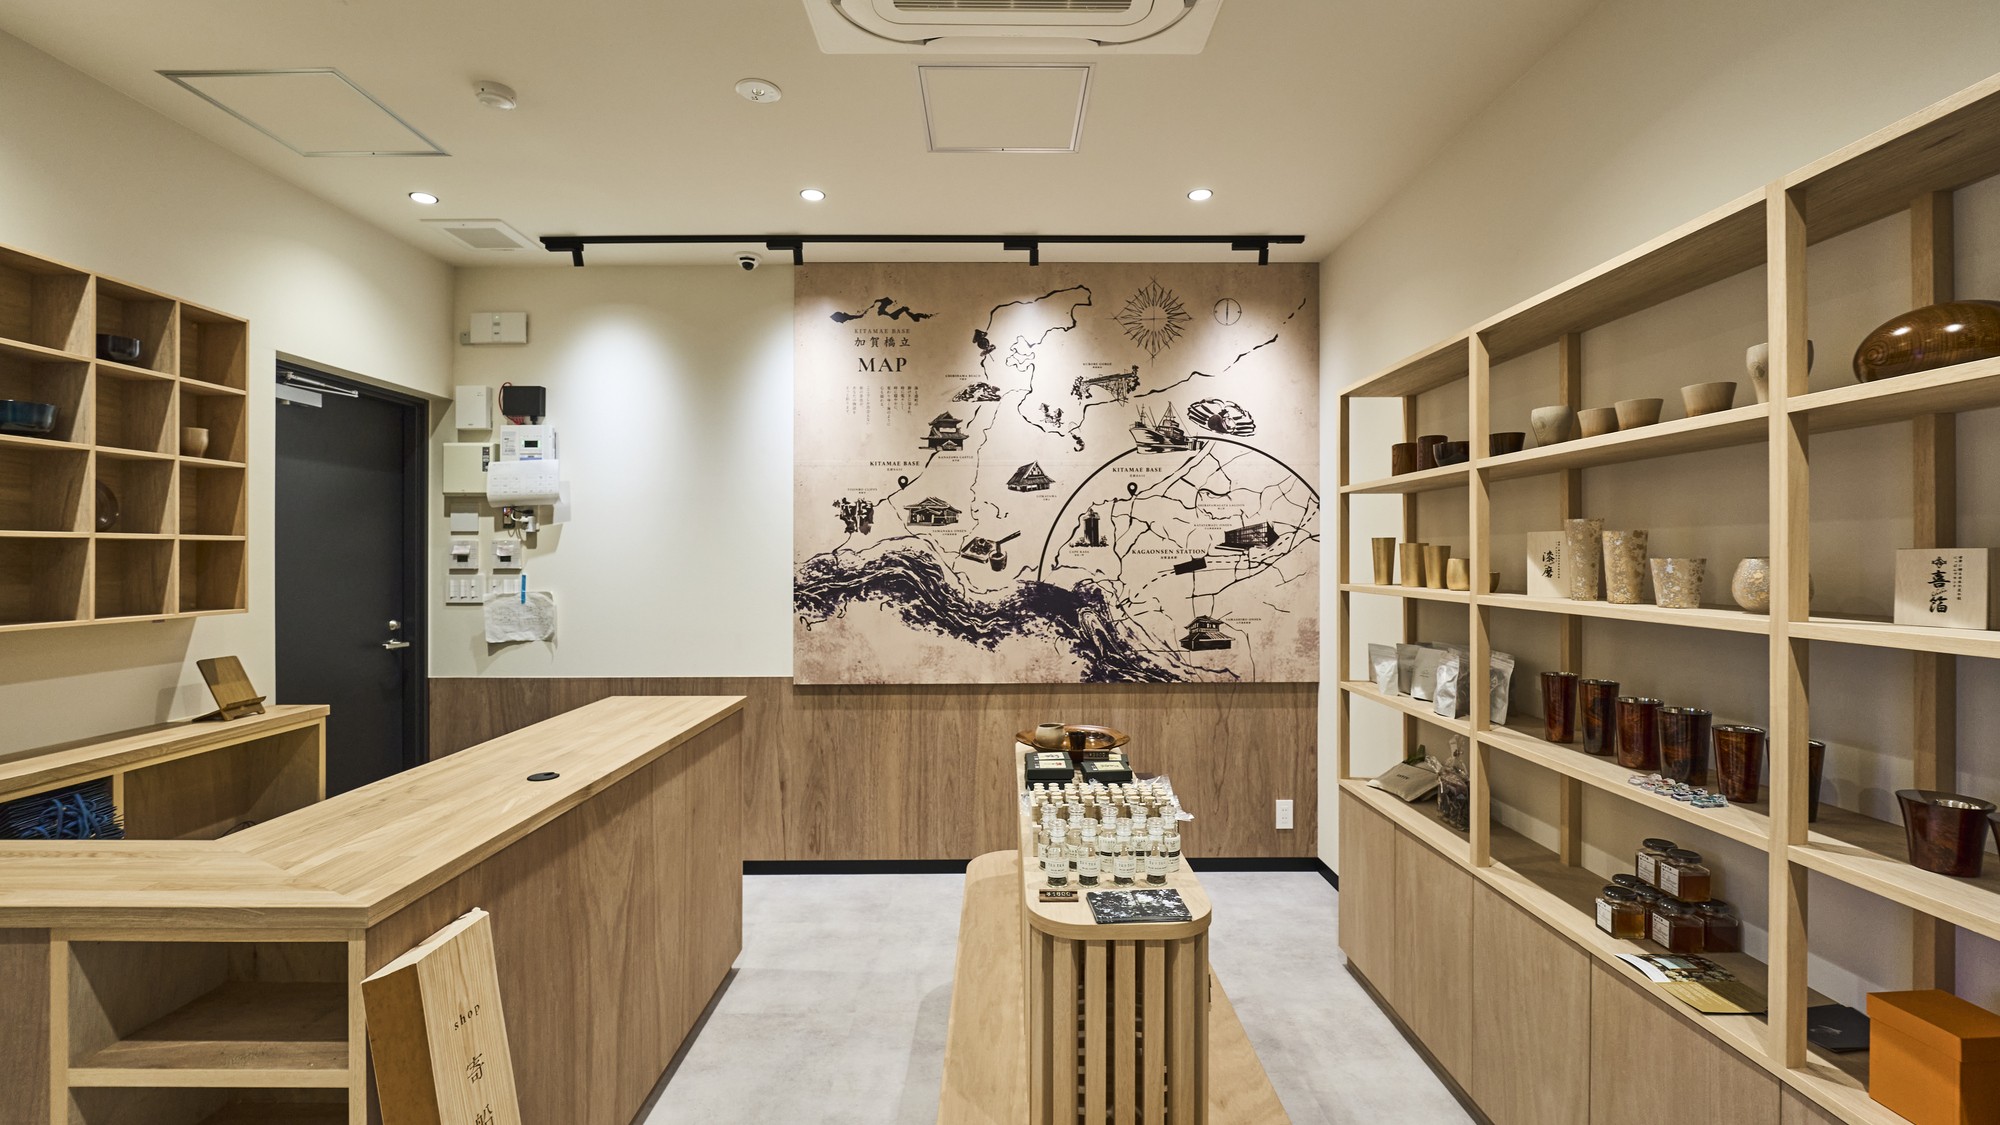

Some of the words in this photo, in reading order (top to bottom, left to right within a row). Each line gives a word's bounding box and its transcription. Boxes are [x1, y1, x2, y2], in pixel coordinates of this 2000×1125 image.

[854, 336, 911, 348] 加賀橋立
[858, 357, 907, 372] MAP
[454, 1004, 480, 1031] shop
